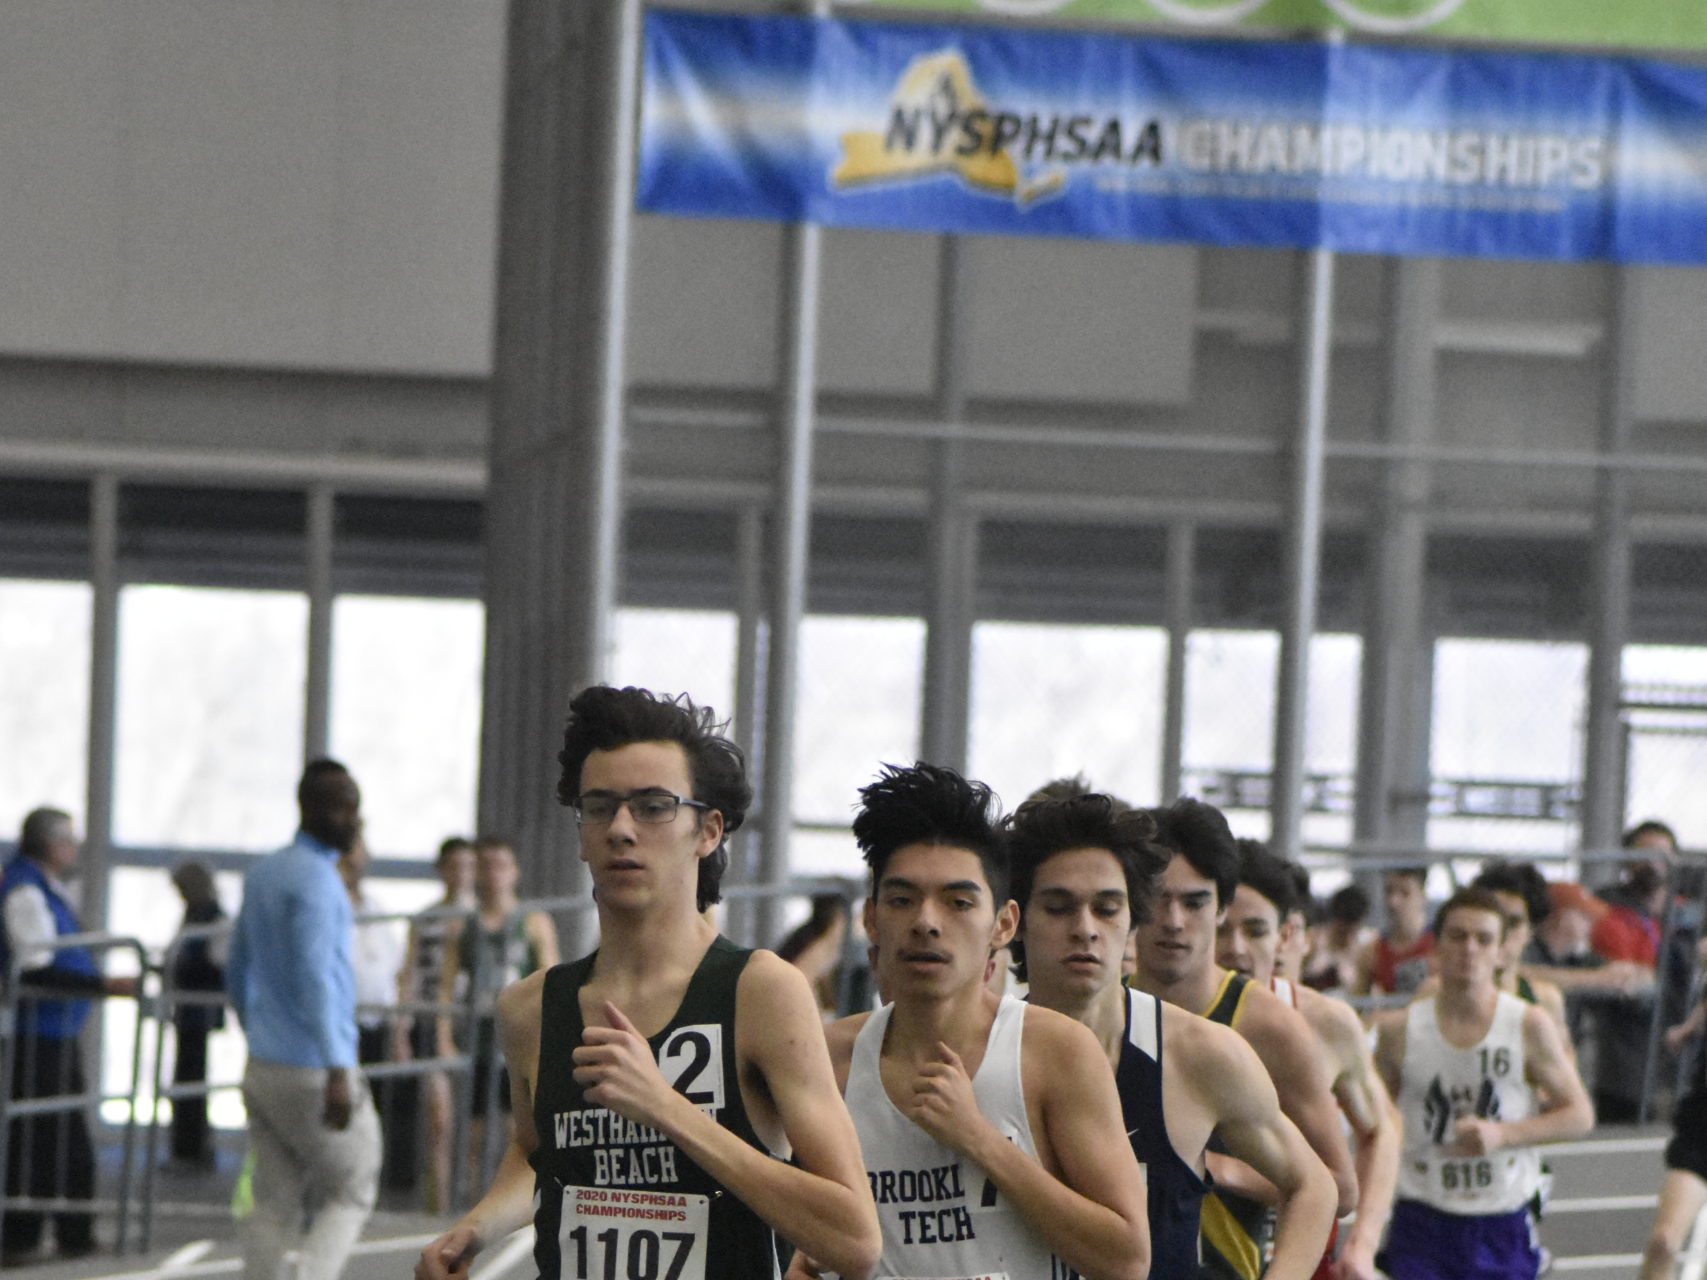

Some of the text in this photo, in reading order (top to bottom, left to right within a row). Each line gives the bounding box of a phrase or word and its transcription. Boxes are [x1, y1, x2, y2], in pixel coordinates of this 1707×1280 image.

[885, 107, 1604, 190] NYSPHSAA CHAMPIONSHIPS
[667, 1031, 714, 1104] 2
[1478, 1047, 1511, 1077] 16
[594, 1146, 679, 1186] BEACH
[867, 1163, 966, 1203] BROOKL
[576, 1189, 687, 1207] 2020 NYSPHSAA
[576, 1204, 687, 1222] CHAMPIONSHIPS
[899, 1206, 976, 1244] TECH
